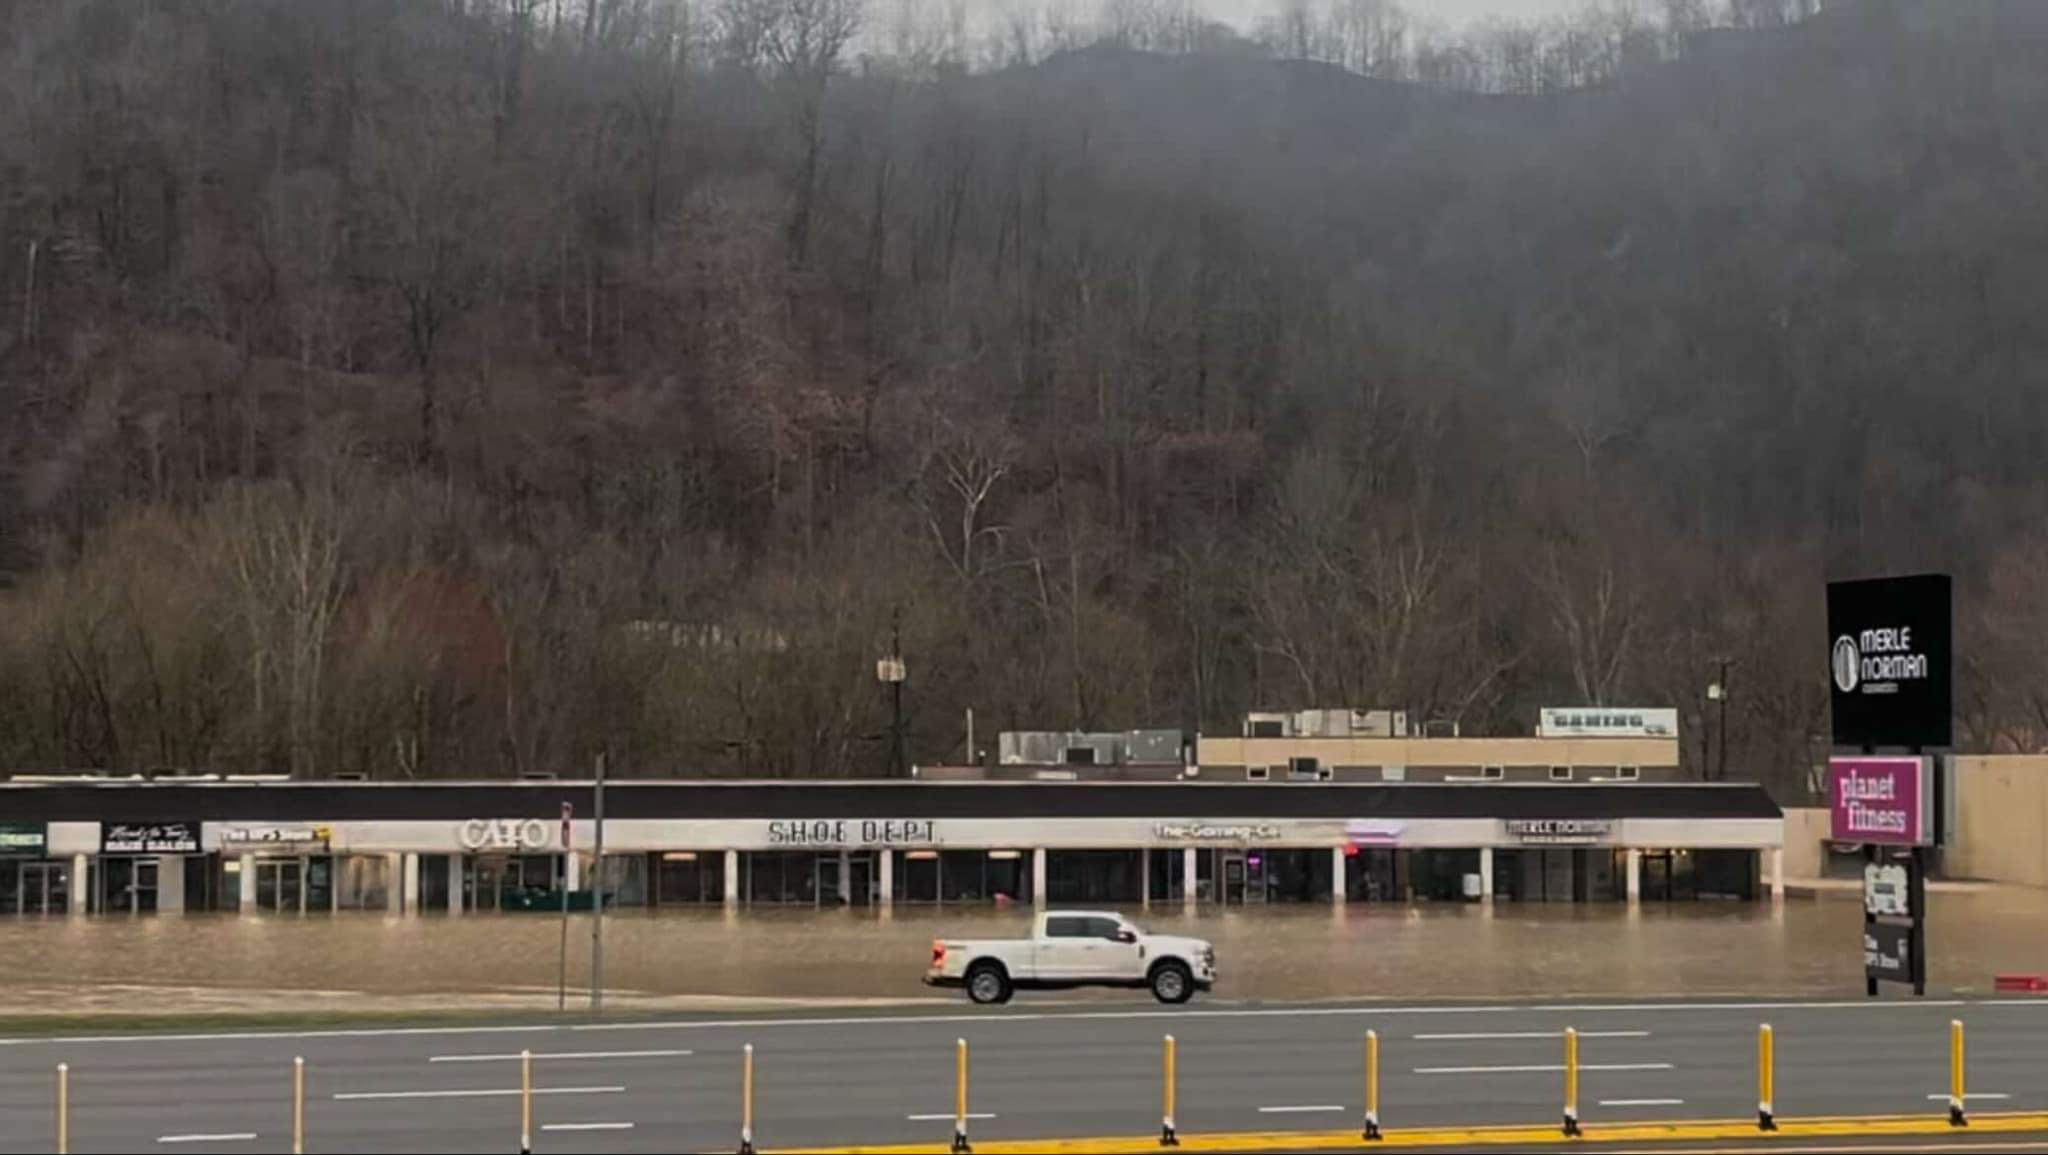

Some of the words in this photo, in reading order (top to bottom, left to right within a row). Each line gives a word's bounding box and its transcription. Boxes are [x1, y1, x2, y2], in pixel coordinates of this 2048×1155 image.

[1860, 626, 1911, 652] MERLE
[1861, 653, 1928, 680] NORMAN
[1839, 767, 1896, 808] planet
[1848, 800, 1906, 833] fitness
[461, 819, 549, 848] CATO
[769, 820, 847, 843] SHOE
